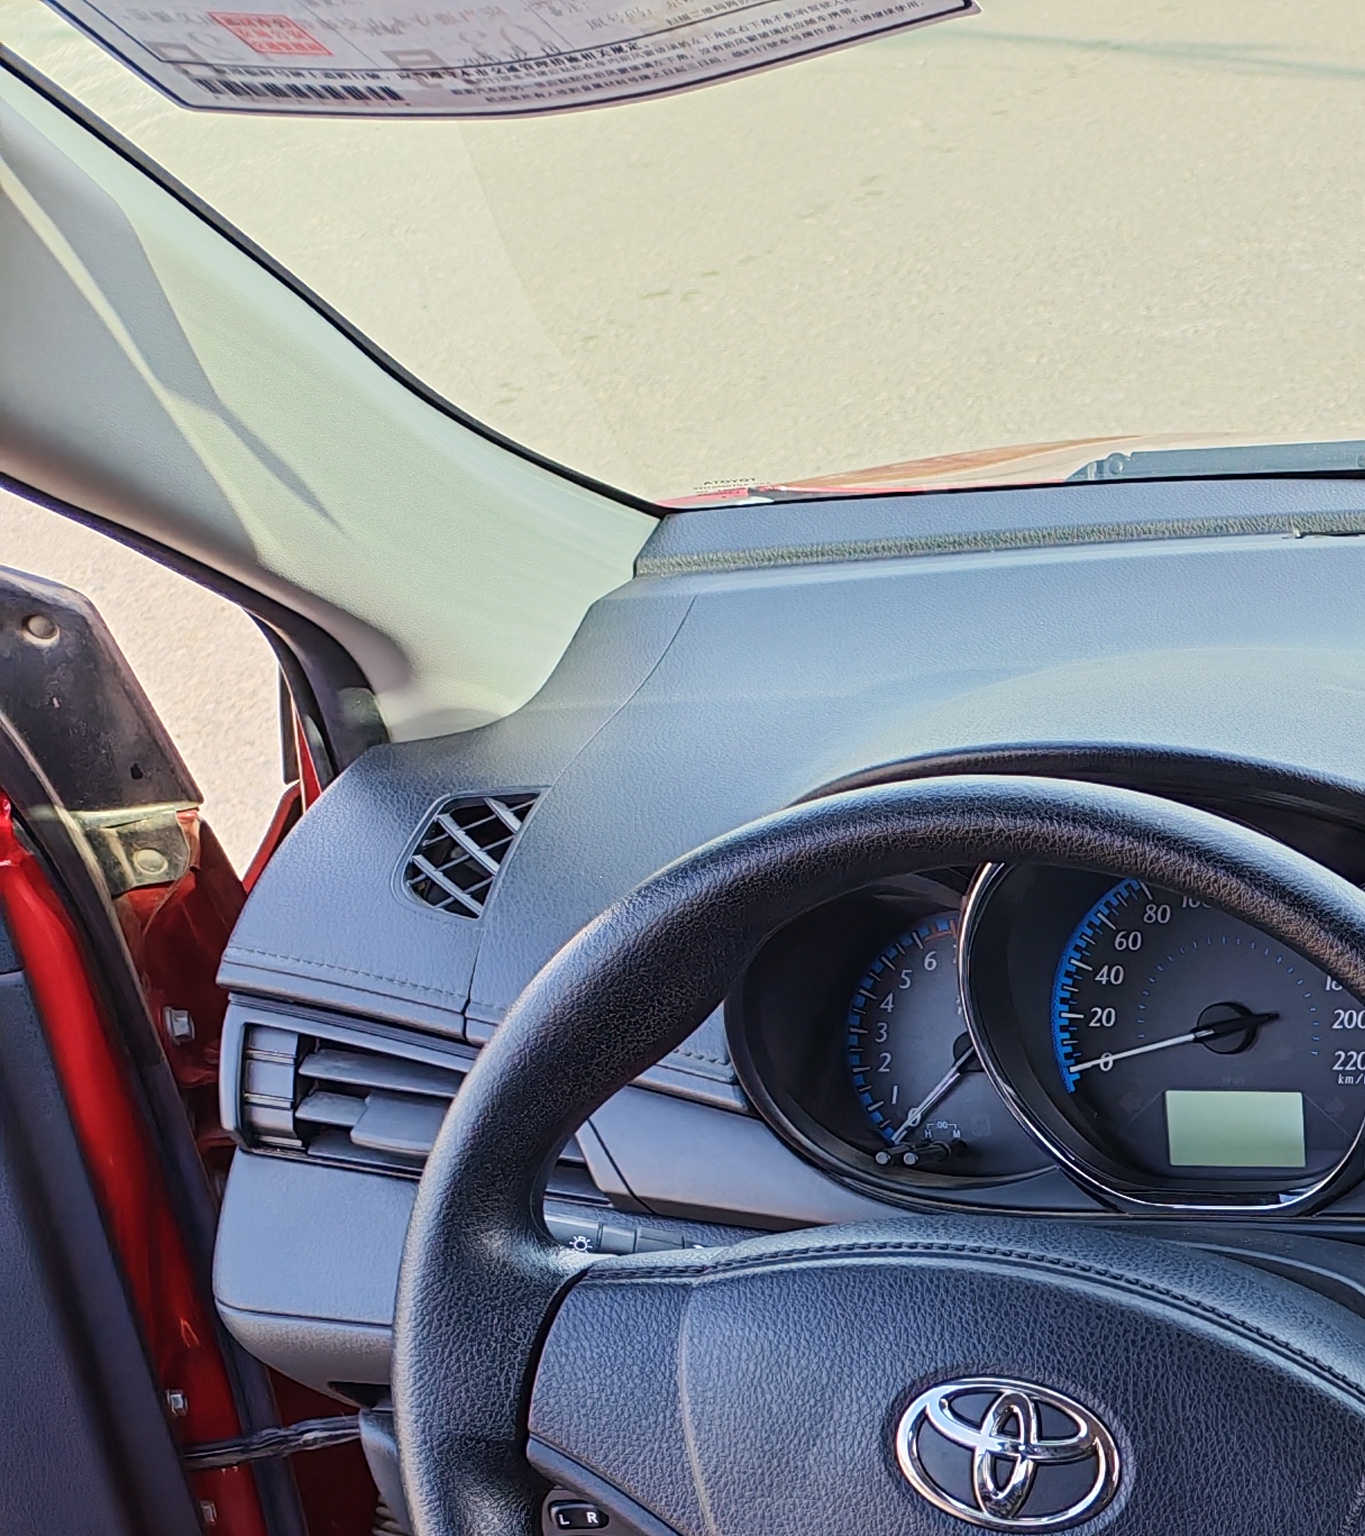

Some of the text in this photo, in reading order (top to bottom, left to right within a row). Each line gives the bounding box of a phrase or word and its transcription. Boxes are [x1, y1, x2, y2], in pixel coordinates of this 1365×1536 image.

[1143, 904, 1171, 924] 80
[1114, 931, 1142, 951] 60
[924, 951, 937, 971] 6
[899, 970, 913, 989] 5
[1094, 965, 1124, 985] 40
[880, 992, 894, 1012] 4
[1089, 1007, 1116, 1027] 20
[875, 1023, 888, 1043] 3
[878, 1053, 892, 1072] 2
[1099, 1052, 1114, 1071] 0
[891, 1085, 898, 1104] 1
[924, 1129, 933, 1139] H
[559, 1511, 598, 1525] L R
